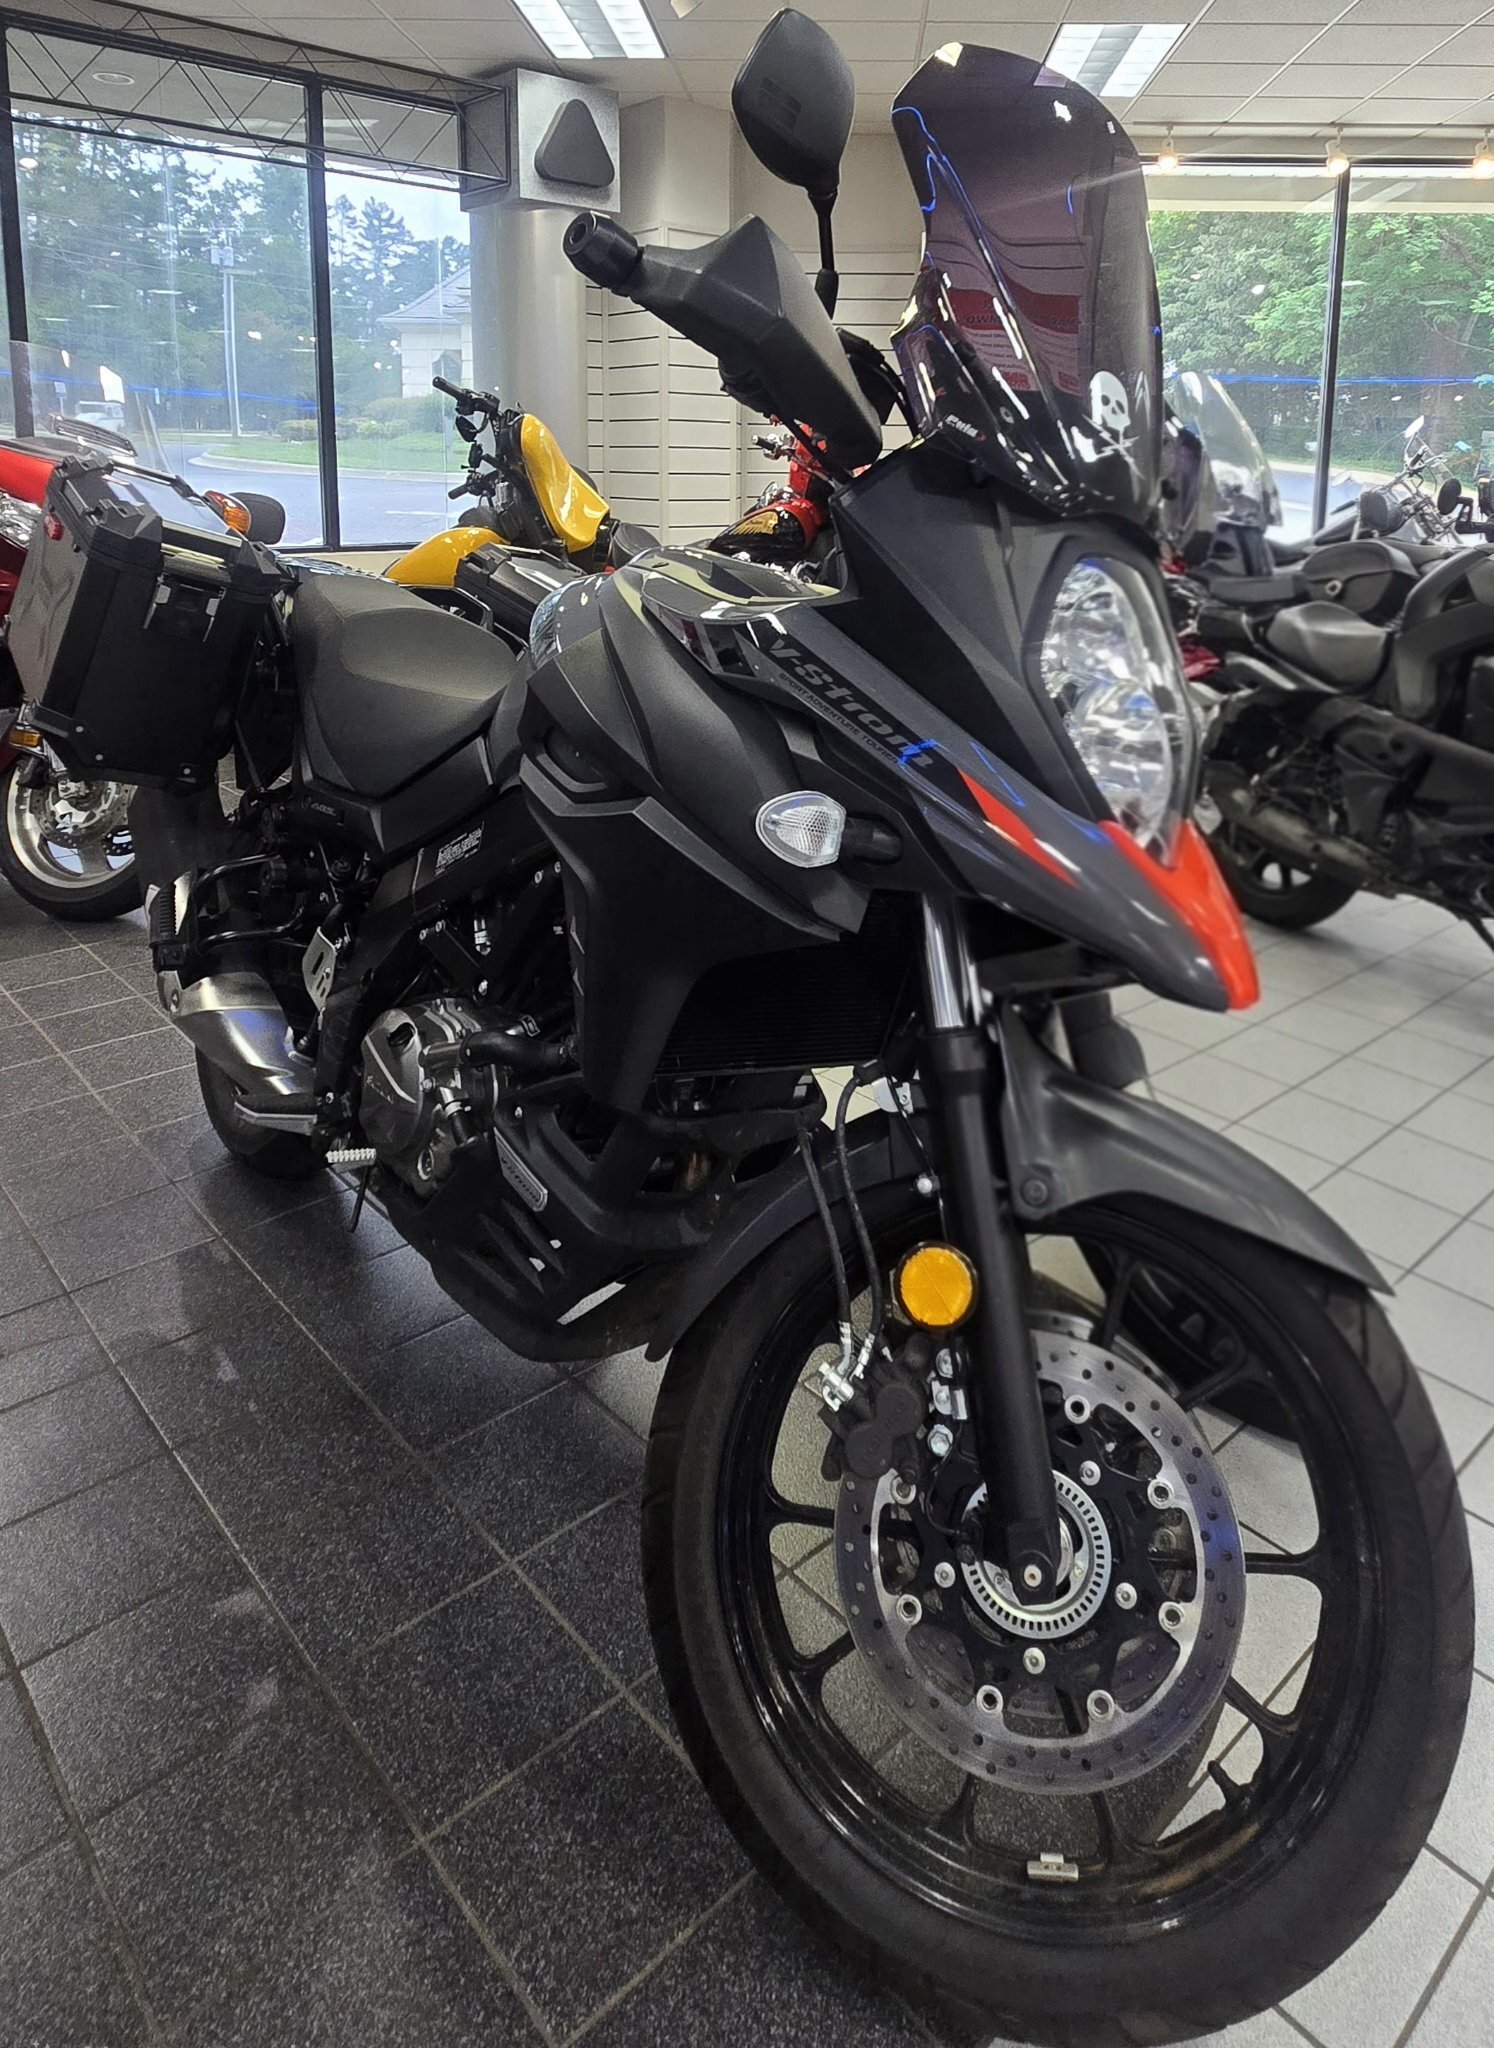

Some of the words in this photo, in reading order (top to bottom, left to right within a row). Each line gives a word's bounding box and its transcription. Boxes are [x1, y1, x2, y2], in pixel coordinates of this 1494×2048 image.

[778, 672, 808, 695] SPORT
[806, 694, 861, 736] ADVENTURE
[862, 735, 899, 764] TOURER
